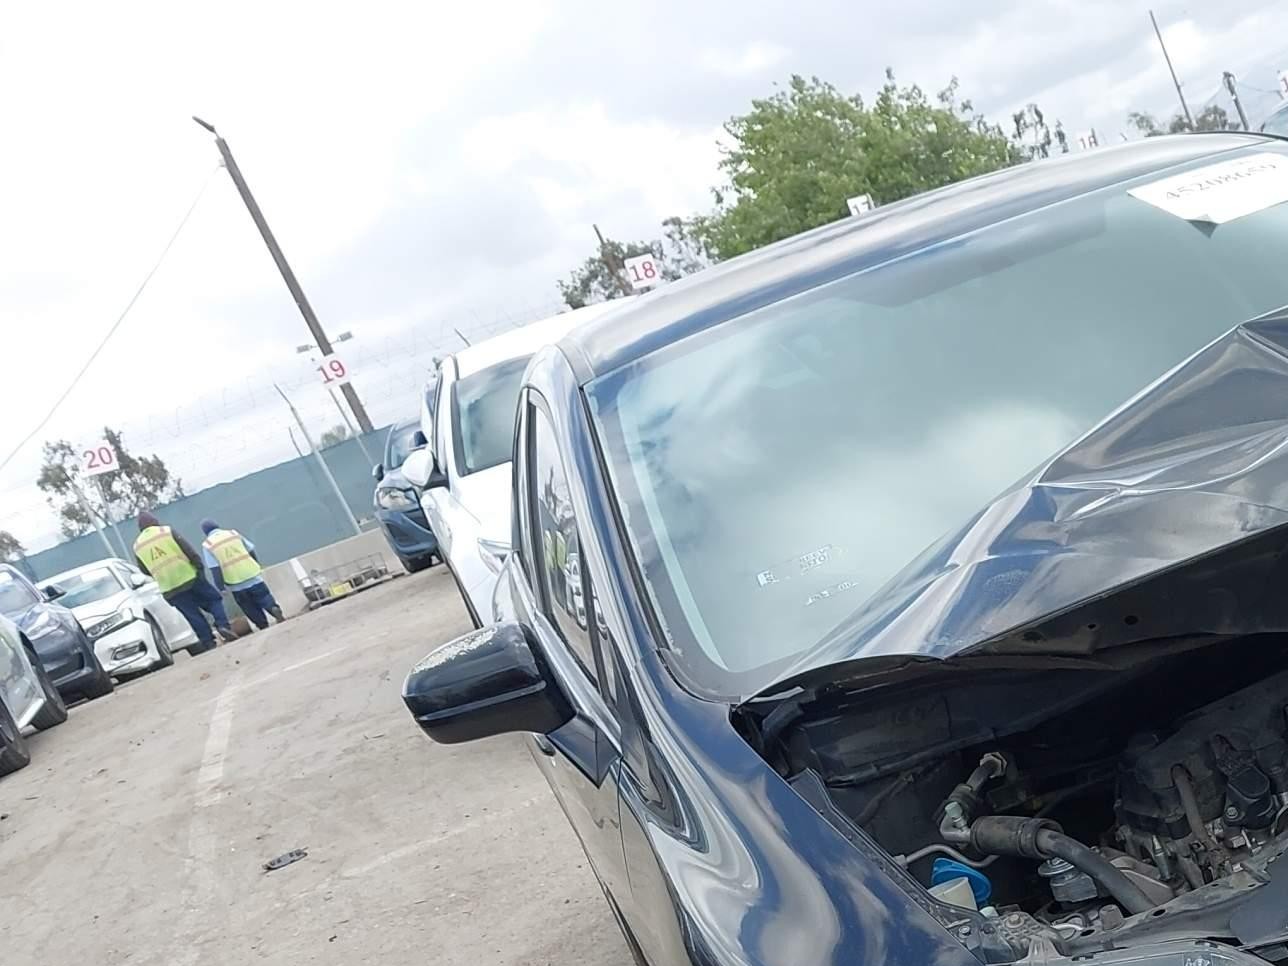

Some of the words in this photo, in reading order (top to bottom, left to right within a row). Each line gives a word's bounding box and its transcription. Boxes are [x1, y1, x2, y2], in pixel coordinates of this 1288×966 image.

[629, 260, 656, 283] 18
[316, 359, 346, 384] 19
[82, 446, 113, 469] 20
